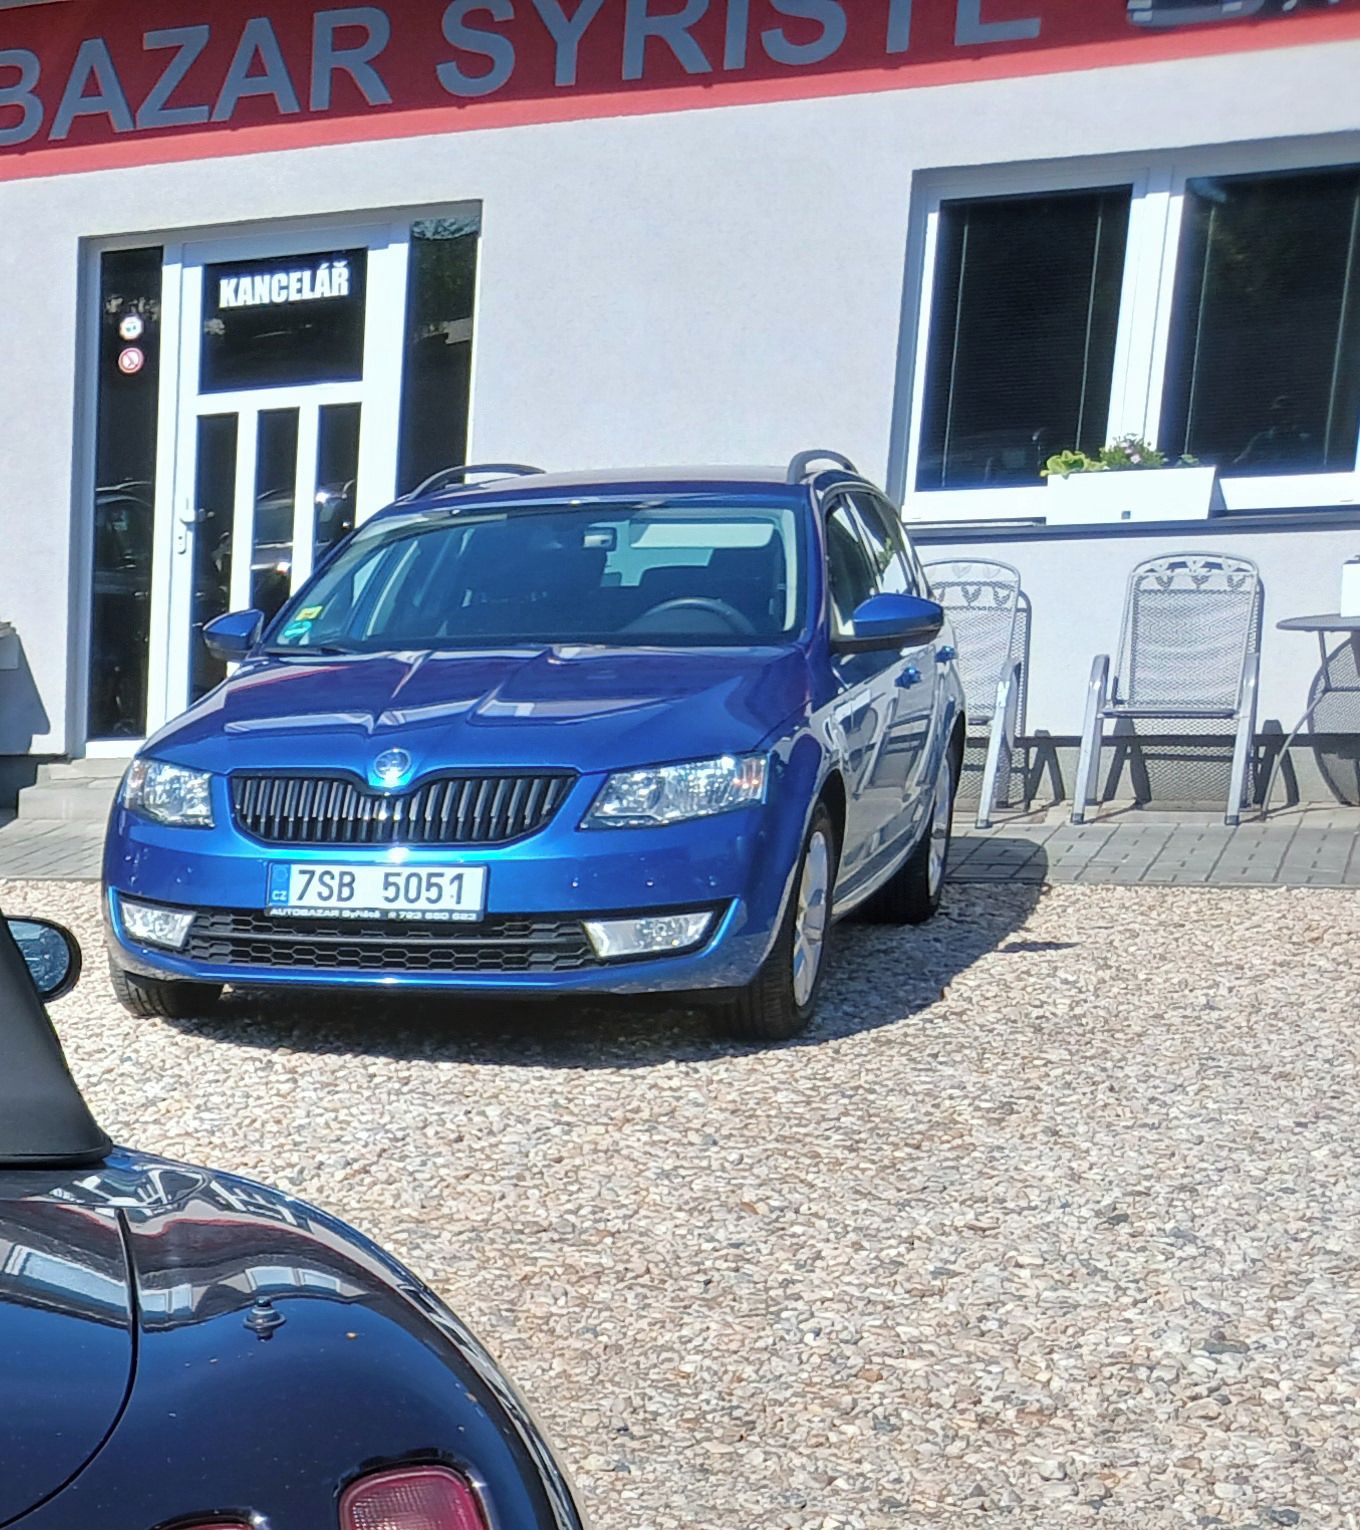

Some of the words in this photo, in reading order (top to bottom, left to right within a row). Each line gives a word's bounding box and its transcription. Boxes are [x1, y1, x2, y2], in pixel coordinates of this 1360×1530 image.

[218, 260, 350, 309] KANCELÁŘ
[272, 890, 288, 901] CZ
[295, 869, 357, 902] 7SB
[381, 872, 465, 905] 5051
